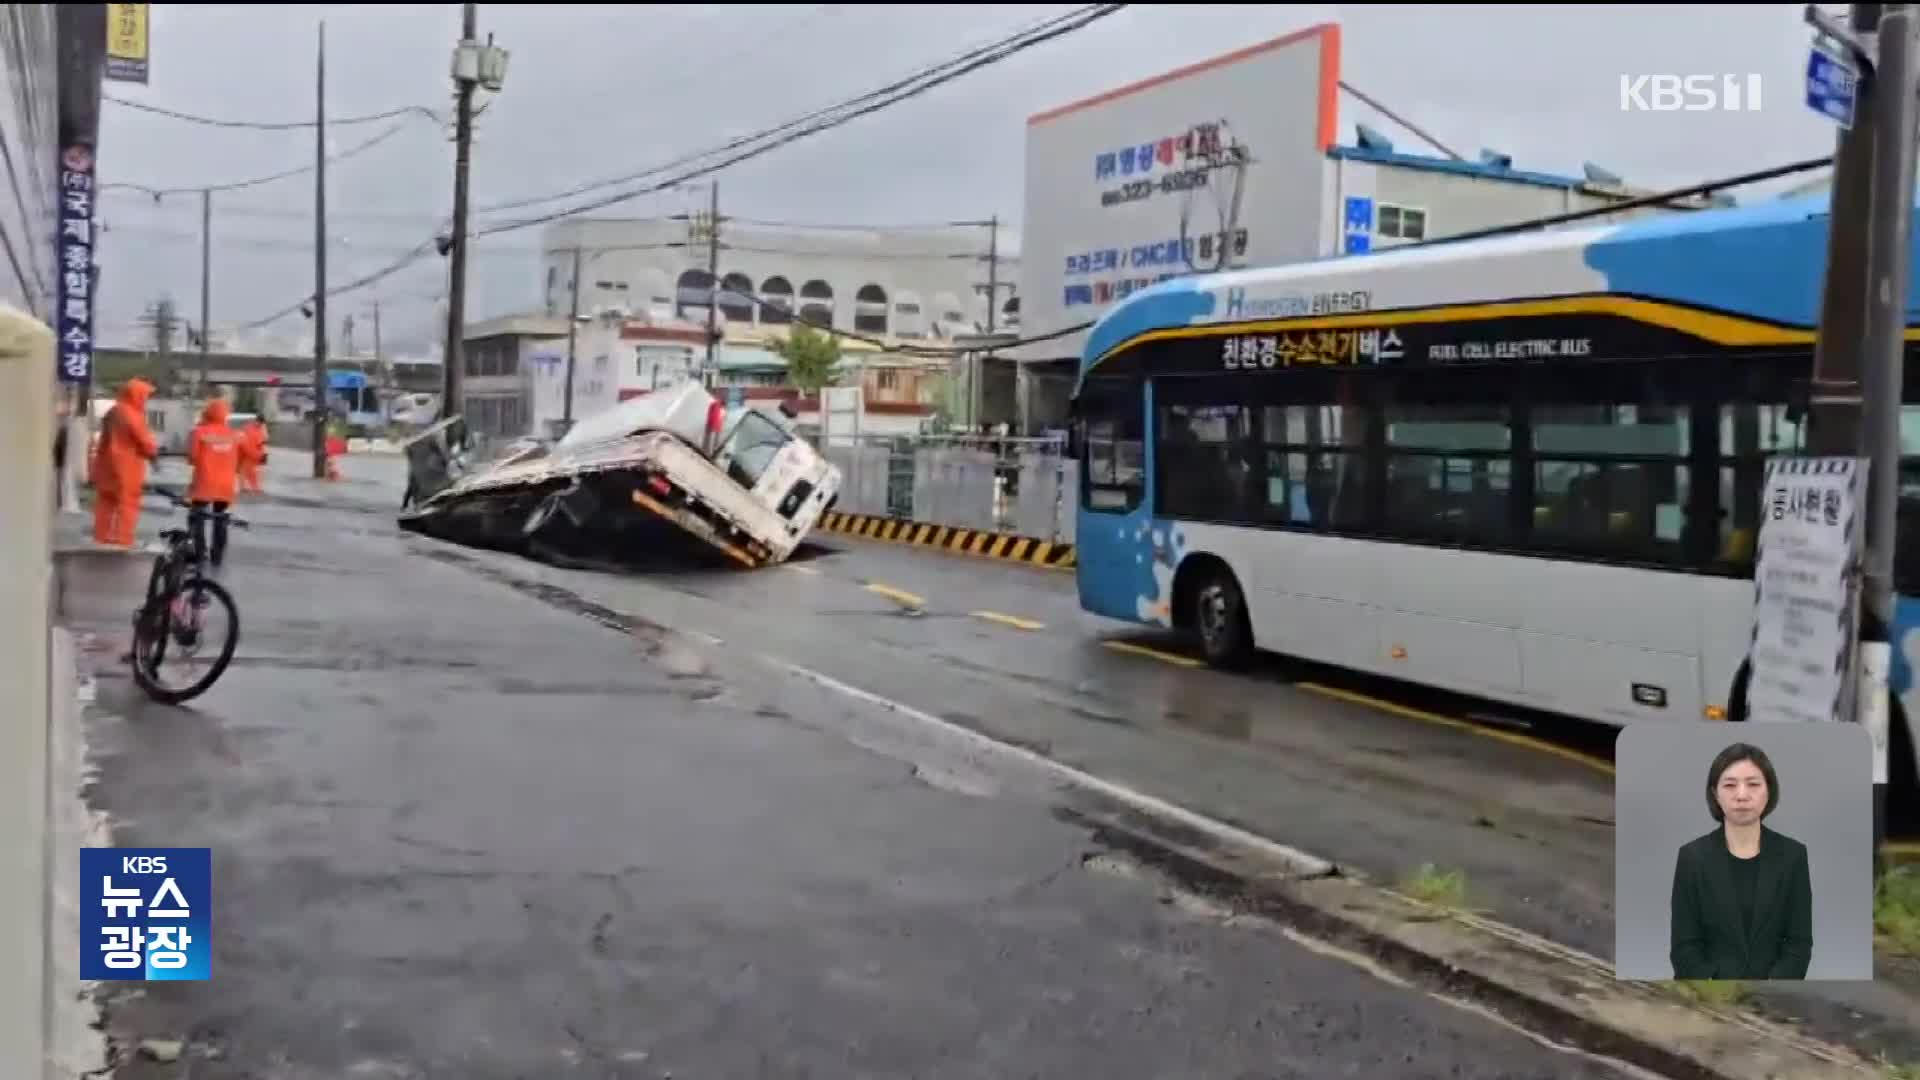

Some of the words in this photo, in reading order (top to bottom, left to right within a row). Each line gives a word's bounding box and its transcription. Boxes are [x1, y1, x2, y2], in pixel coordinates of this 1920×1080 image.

[1312, 288, 1371, 313] ENERGY
[1223, 328, 1404, 370] 친환경수소전기버스
[1462, 342, 1490, 359] CELL
[1494, 339, 1556, 358] ELECTRIC
[1559, 339, 1591, 355] BUS
